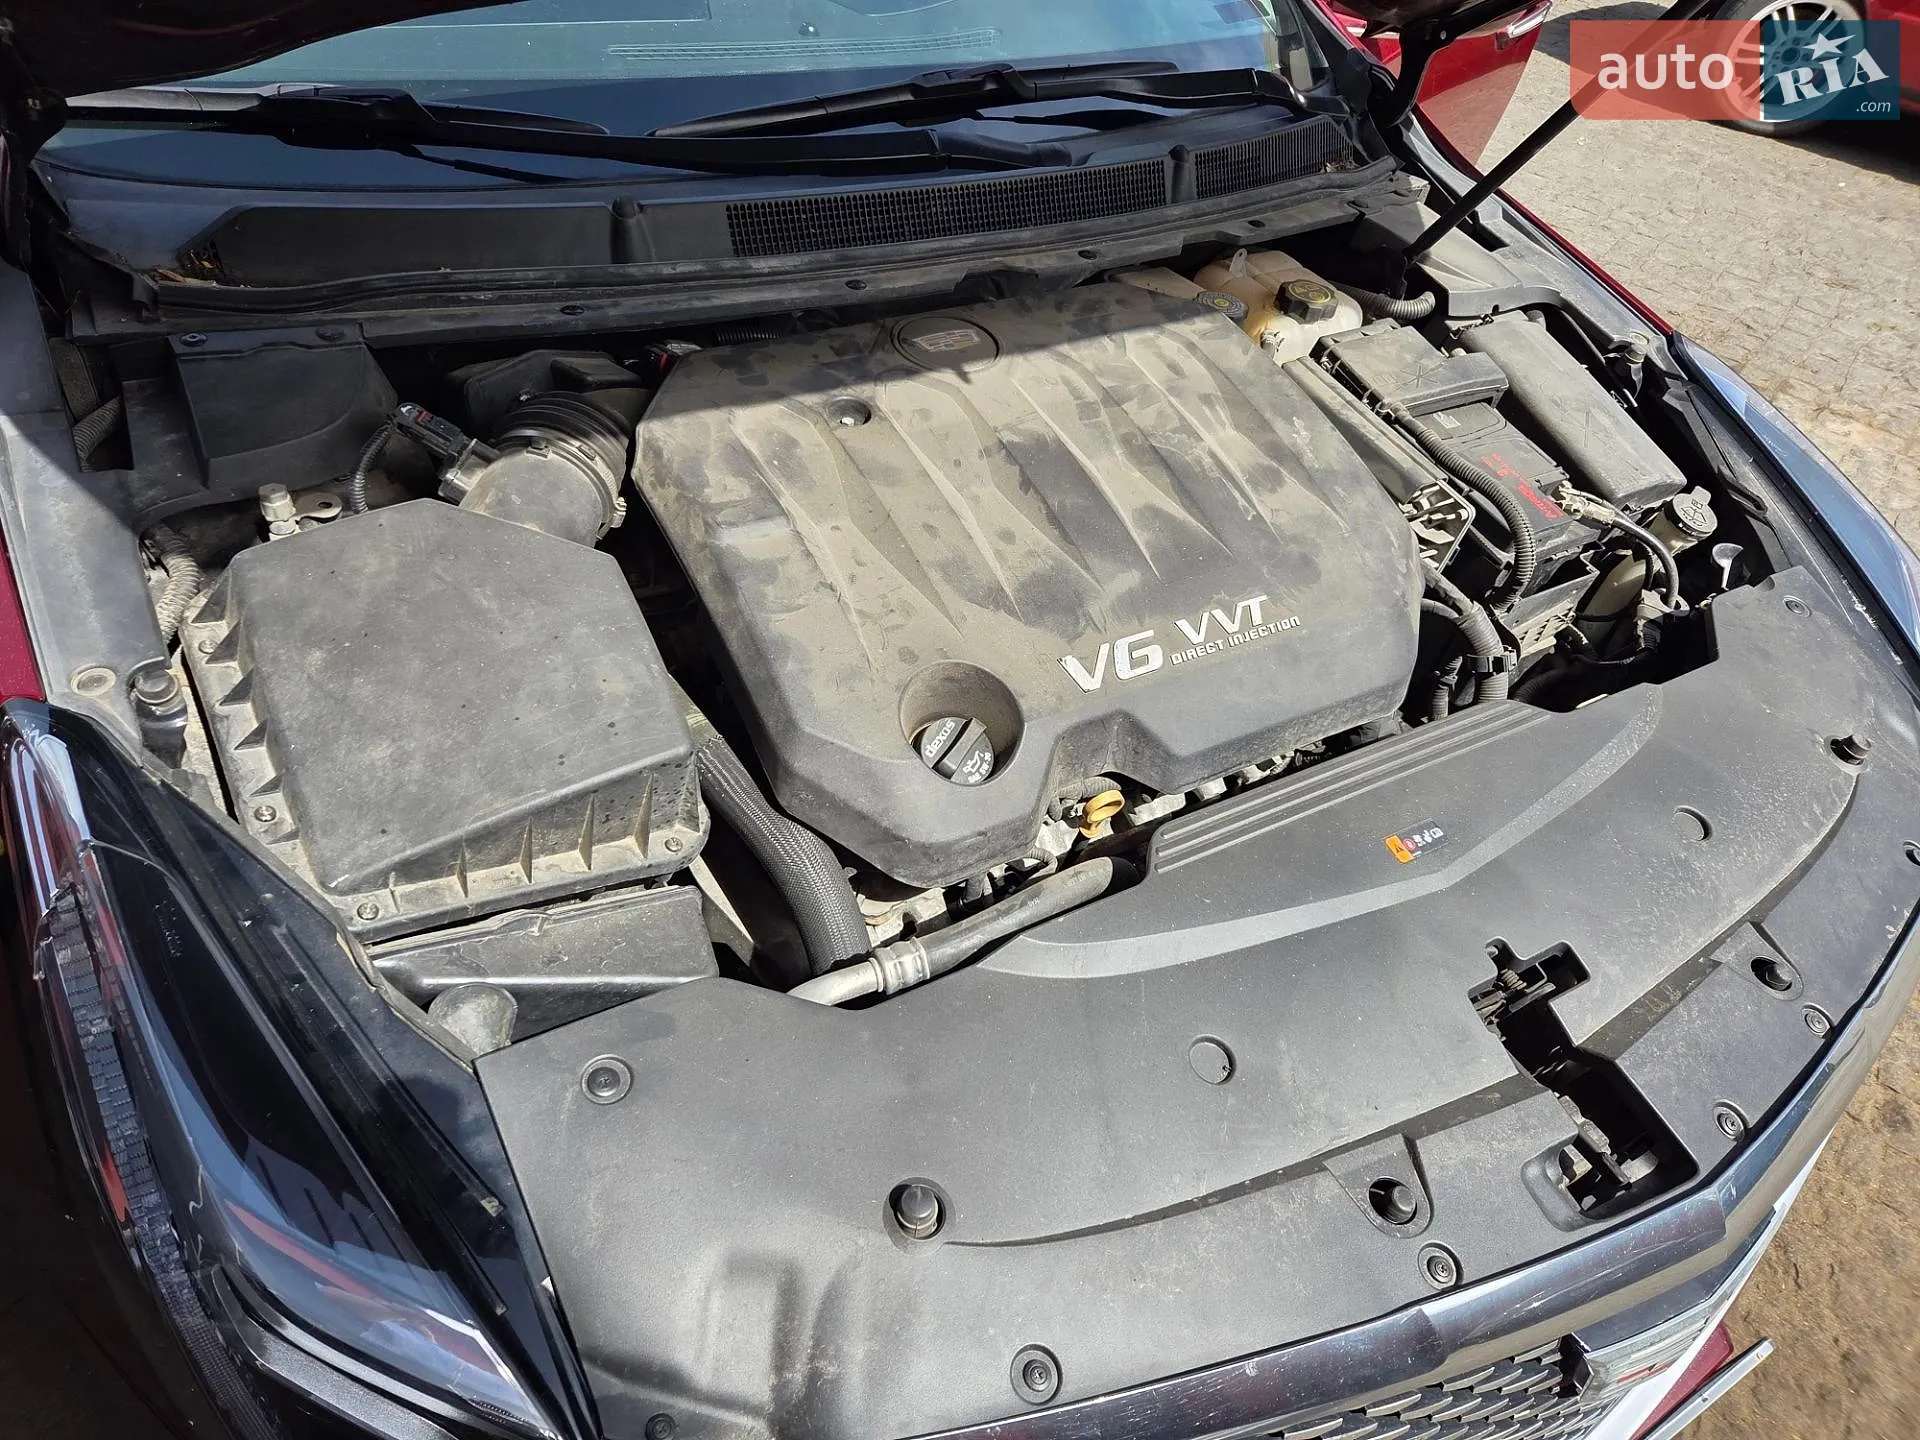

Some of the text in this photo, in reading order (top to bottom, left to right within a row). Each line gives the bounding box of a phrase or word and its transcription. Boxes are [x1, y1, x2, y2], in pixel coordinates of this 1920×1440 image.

[1057, 594, 1268, 694] V6 VVT
[1170, 615, 1301, 666] DIRECT INJECTION
[925, 719, 956, 758] dexos
